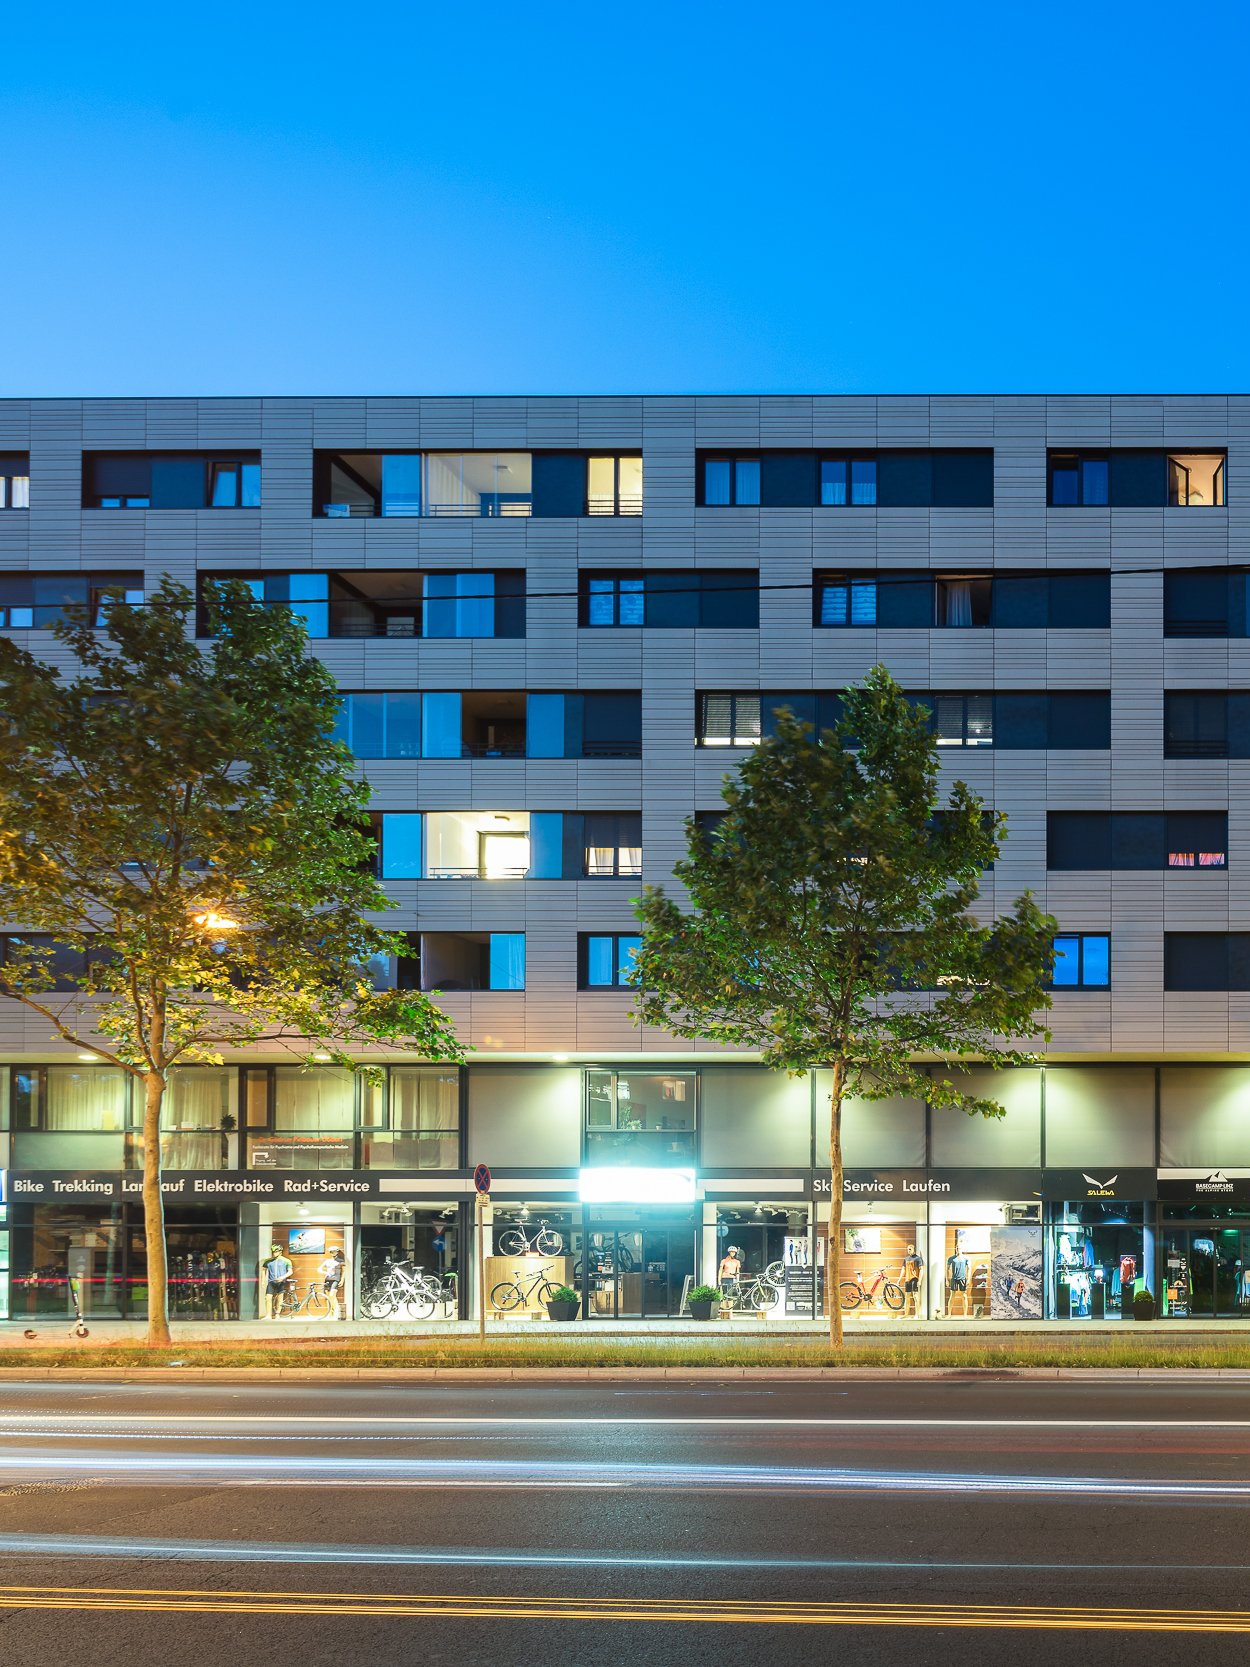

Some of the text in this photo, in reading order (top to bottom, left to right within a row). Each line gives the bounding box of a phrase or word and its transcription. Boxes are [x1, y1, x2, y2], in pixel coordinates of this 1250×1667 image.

[13, 1179, 370, 1195] Bike Trekking Lanauf Elektrobike Rad+Service
[843, 1179, 893, 1192] Service
[902, 1179, 950, 1192] Laufen
